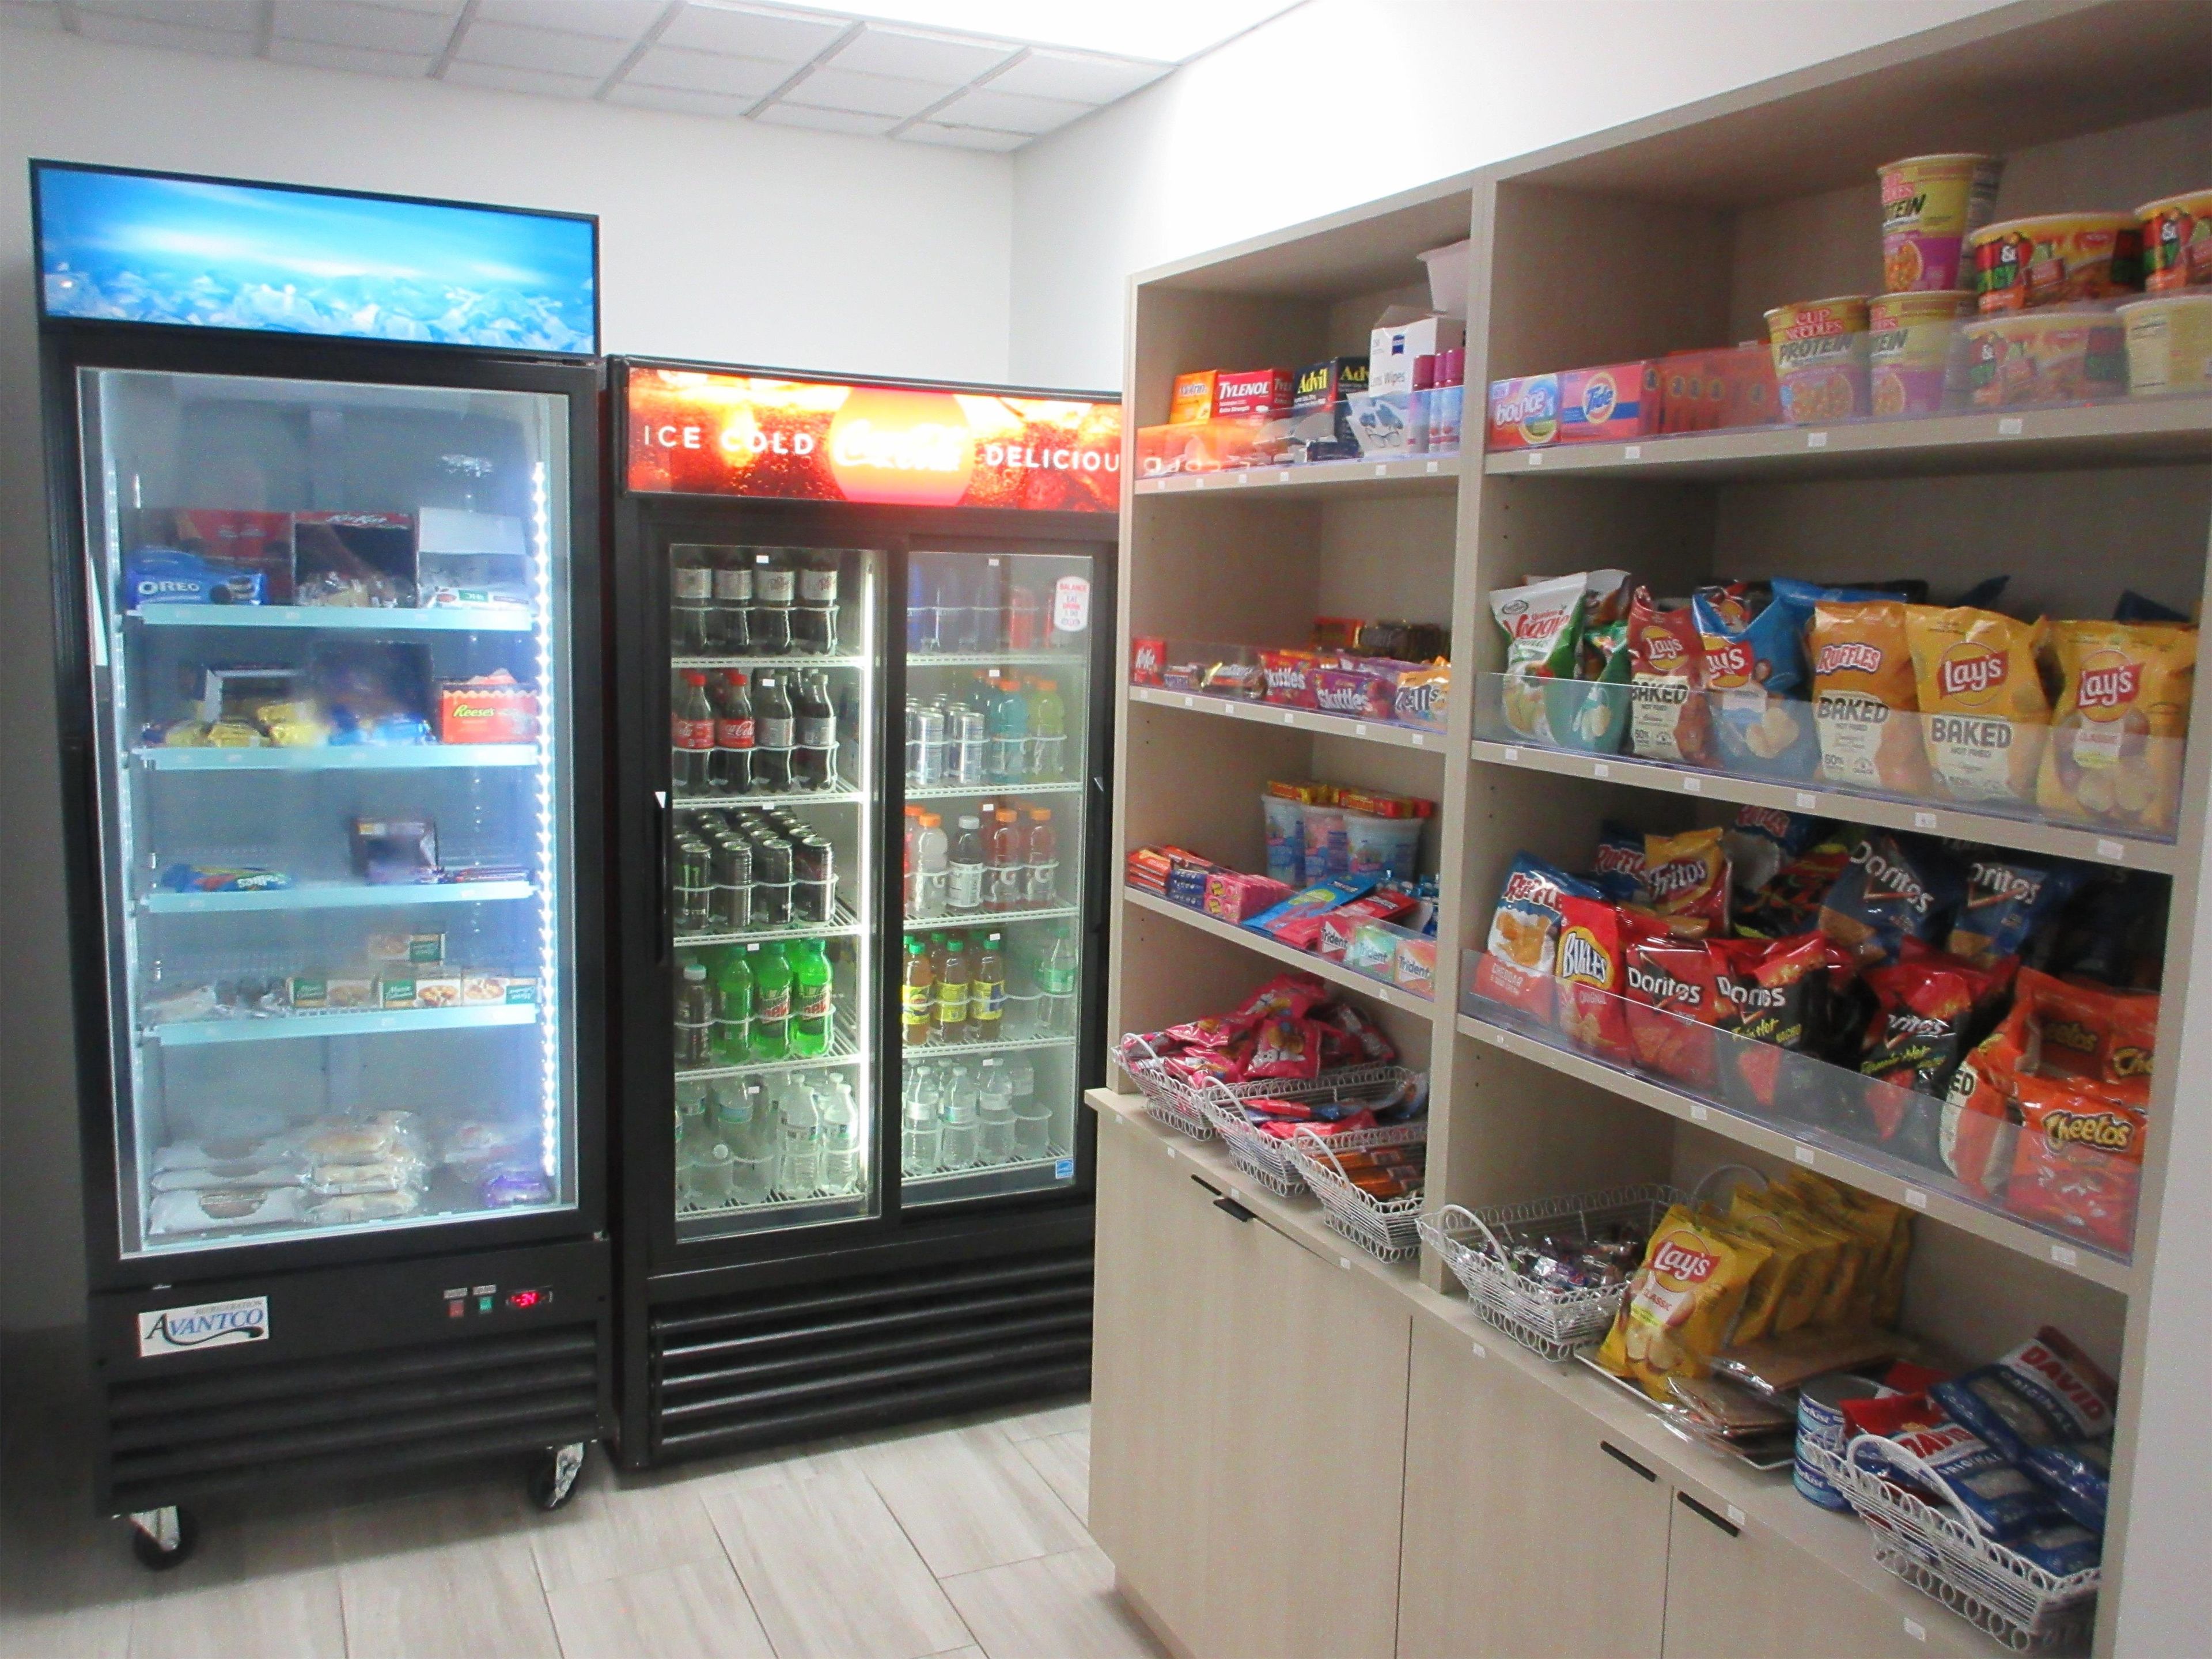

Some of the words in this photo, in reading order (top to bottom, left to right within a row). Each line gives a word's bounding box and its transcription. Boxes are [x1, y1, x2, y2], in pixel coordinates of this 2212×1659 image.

[1219, 381, 1270, 400] TYLENOL
[1298, 367, 1328, 394] Advil
[1587, 384, 1613, 414] Tide
[644, 426, 700, 449] ICE
[721, 430, 815, 456] COLD
[985, 445, 1119, 472] DELICIOU
[138, 581, 200, 594] OREO
[1816, 645, 1881, 673] RUFFLES
[1944, 656, 2003, 692] Lay's
[1317, 688, 1373, 712] Skittles
[1631, 681, 1688, 704] BAKED
[2079, 665, 2134, 706] Lay's
[1817, 696, 1890, 724] BAKED
[1931, 718, 2012, 748] BAKED
[1649, 861, 1708, 896] Fritos
[1321, 928, 1348, 949] Trident
[1359, 941, 1388, 963] Trident
[1399, 955, 1430, 980] Trident
[1627, 967, 1701, 1004] Doritos
[2044, 1114, 2130, 1151] Cheetos
[1654, 1241, 1710, 1281] Lay's
[144, 1308, 264, 1346] AVANTCO
[2021, 1346, 2105, 1421] DAVID
[1898, 1427, 1976, 1460] AVID
